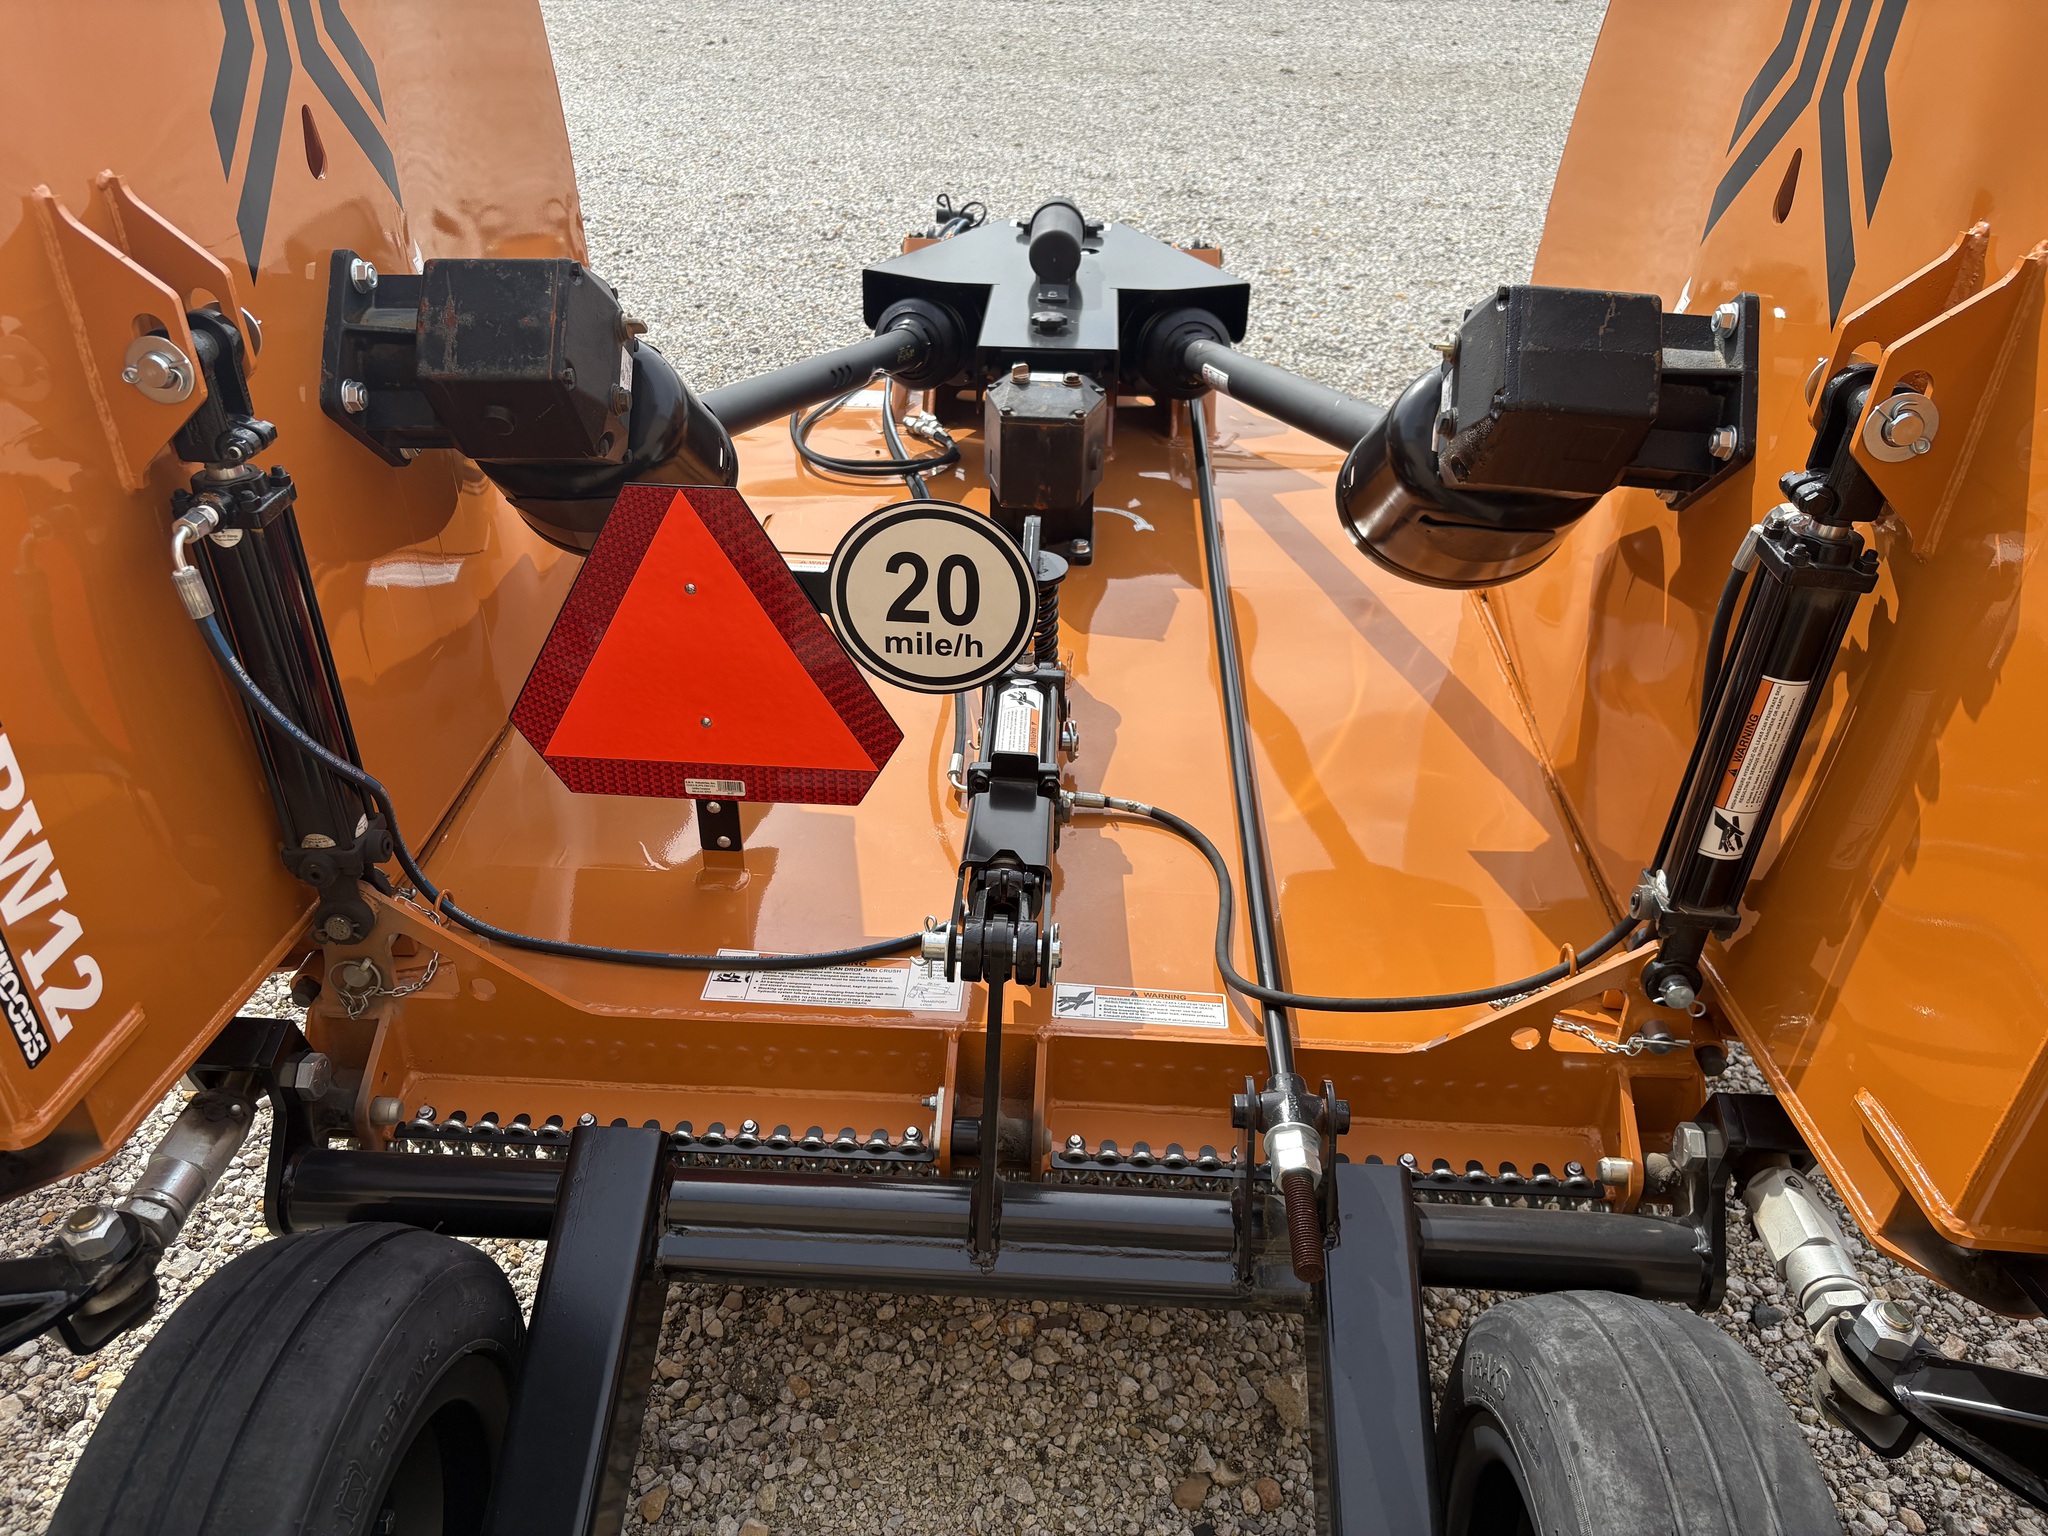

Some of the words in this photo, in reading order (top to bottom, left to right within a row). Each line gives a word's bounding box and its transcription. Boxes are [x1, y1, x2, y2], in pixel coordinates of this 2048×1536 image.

[885, 551, 980, 627] 20
[884, 632, 983, 658] mile/h
[1733, 713, 1759, 763] WARNING
[1144, 992, 1186, 1000] WARNING
